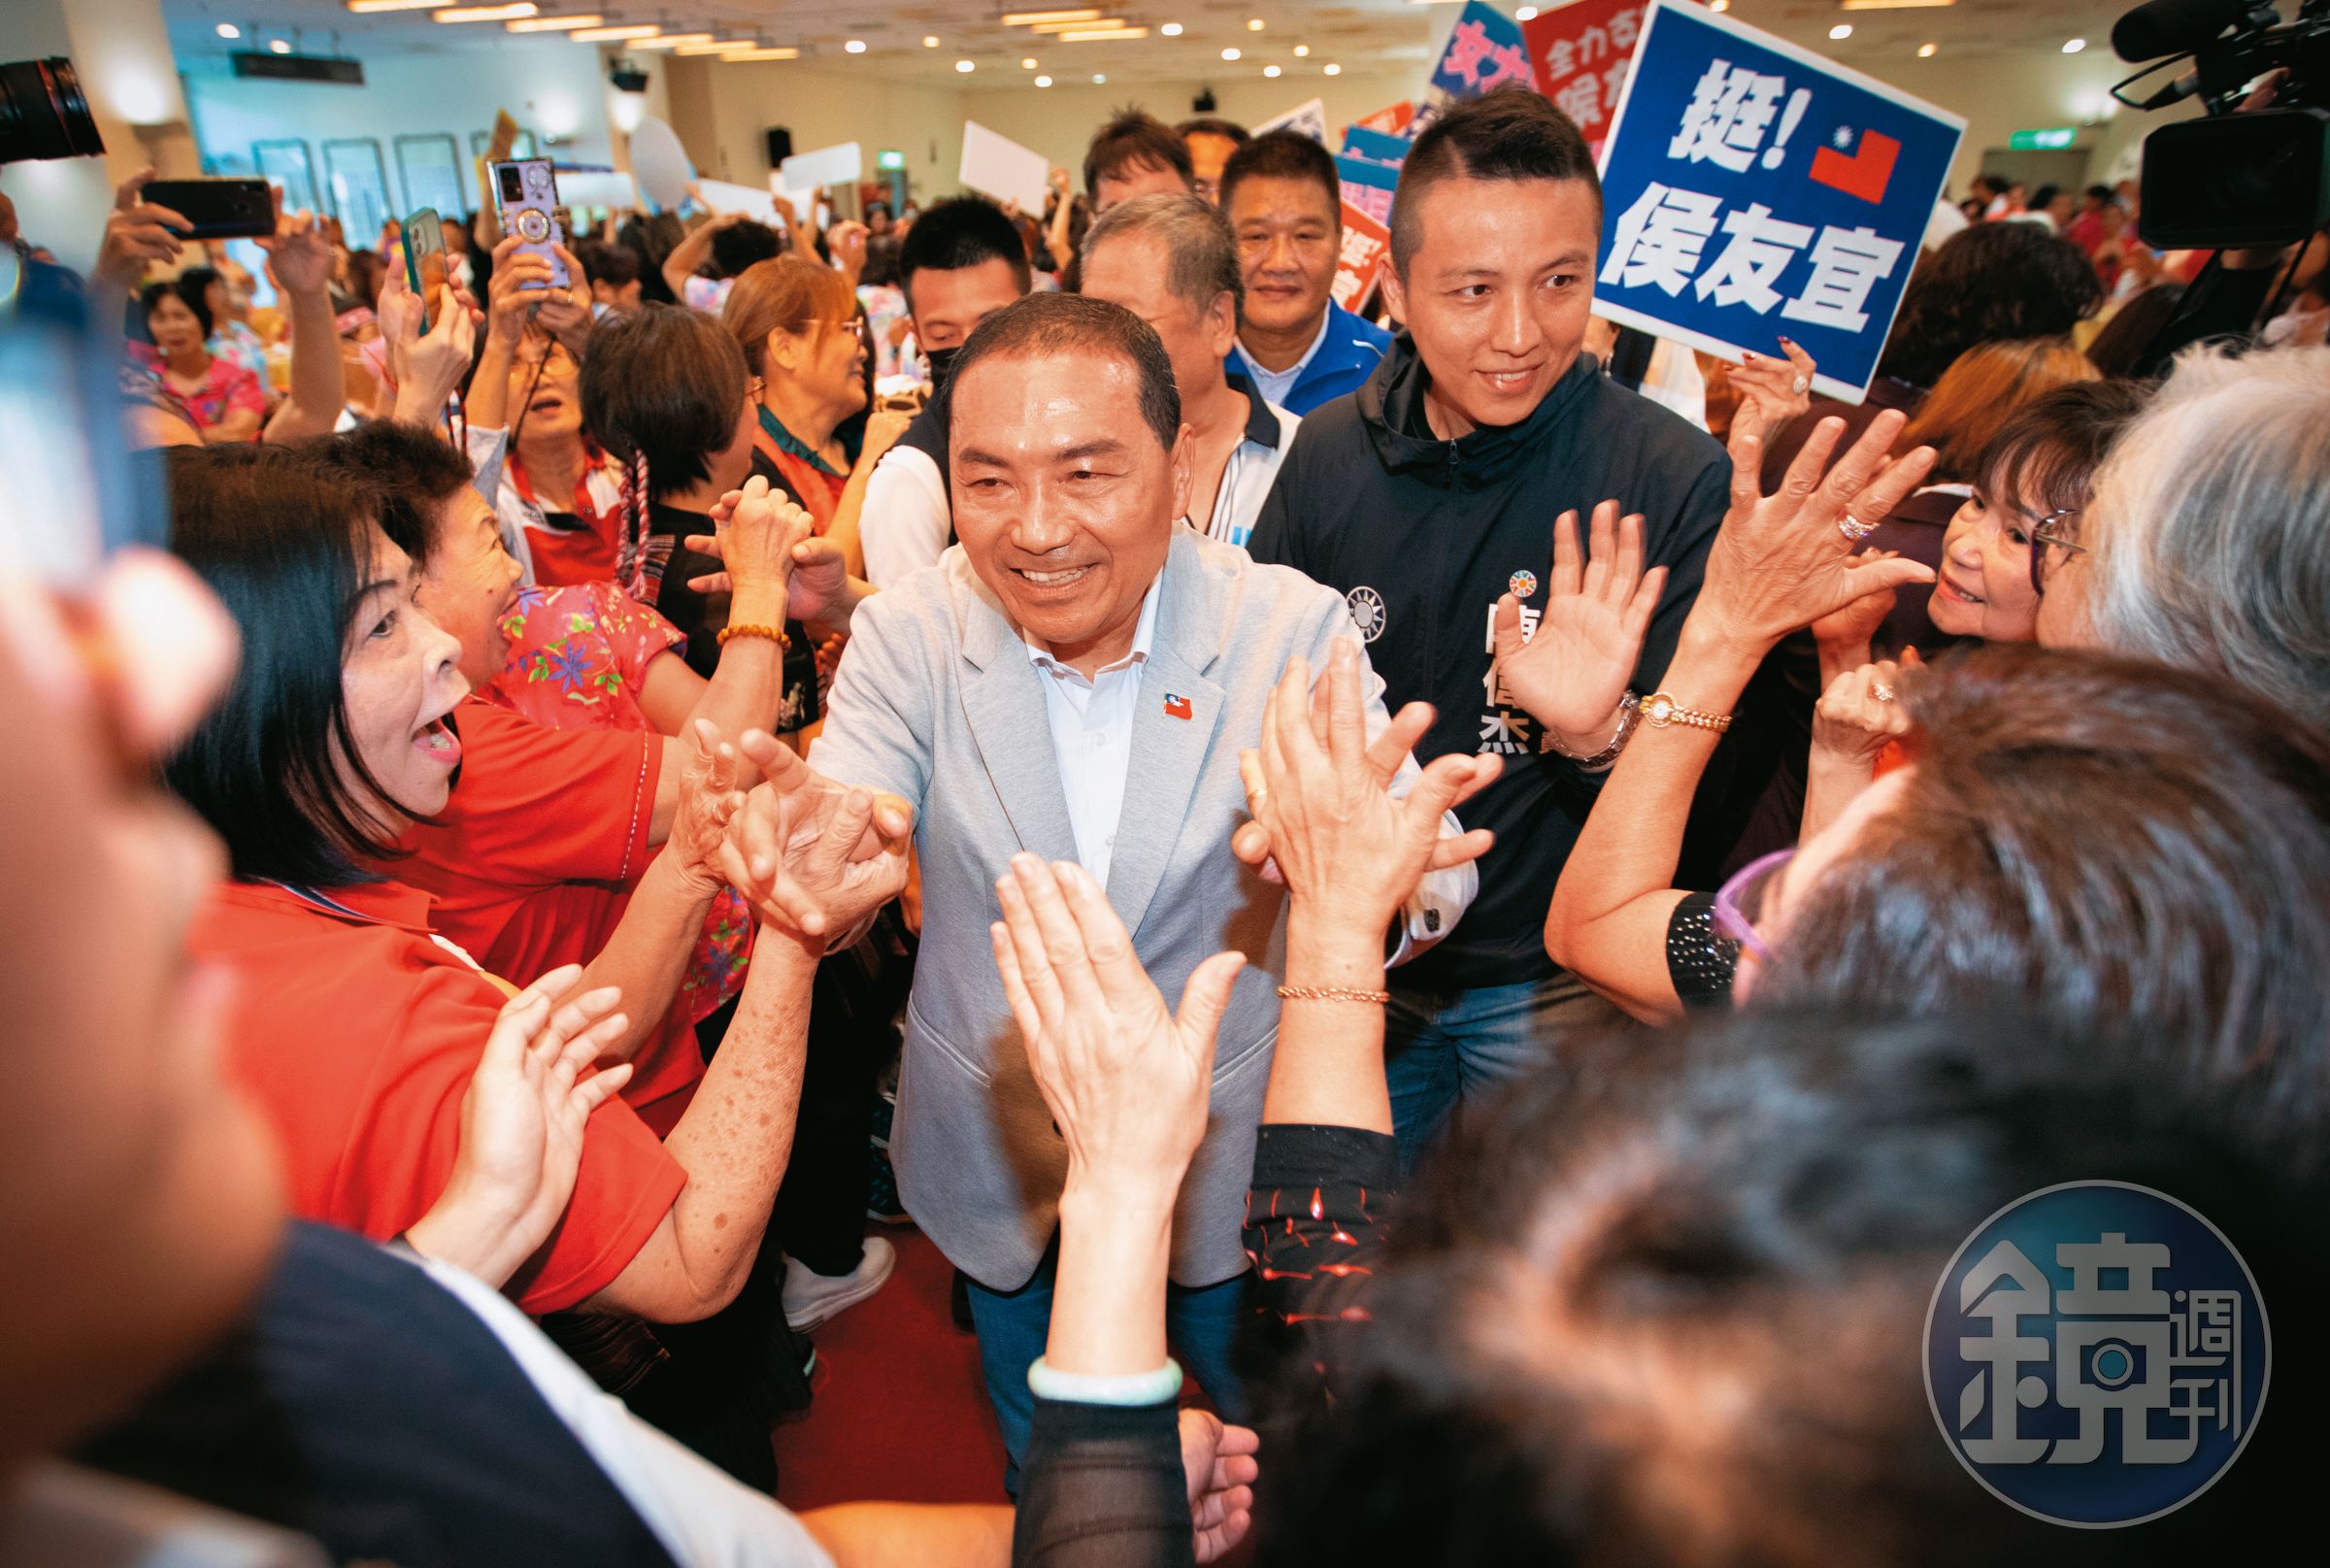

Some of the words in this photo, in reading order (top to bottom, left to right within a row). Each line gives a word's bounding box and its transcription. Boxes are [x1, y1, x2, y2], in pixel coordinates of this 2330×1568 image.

[1546, 5, 1648, 81] 全力支
[1667, 58, 1813, 174] 挺!
[1598, 181, 1906, 333] 侯友宜
